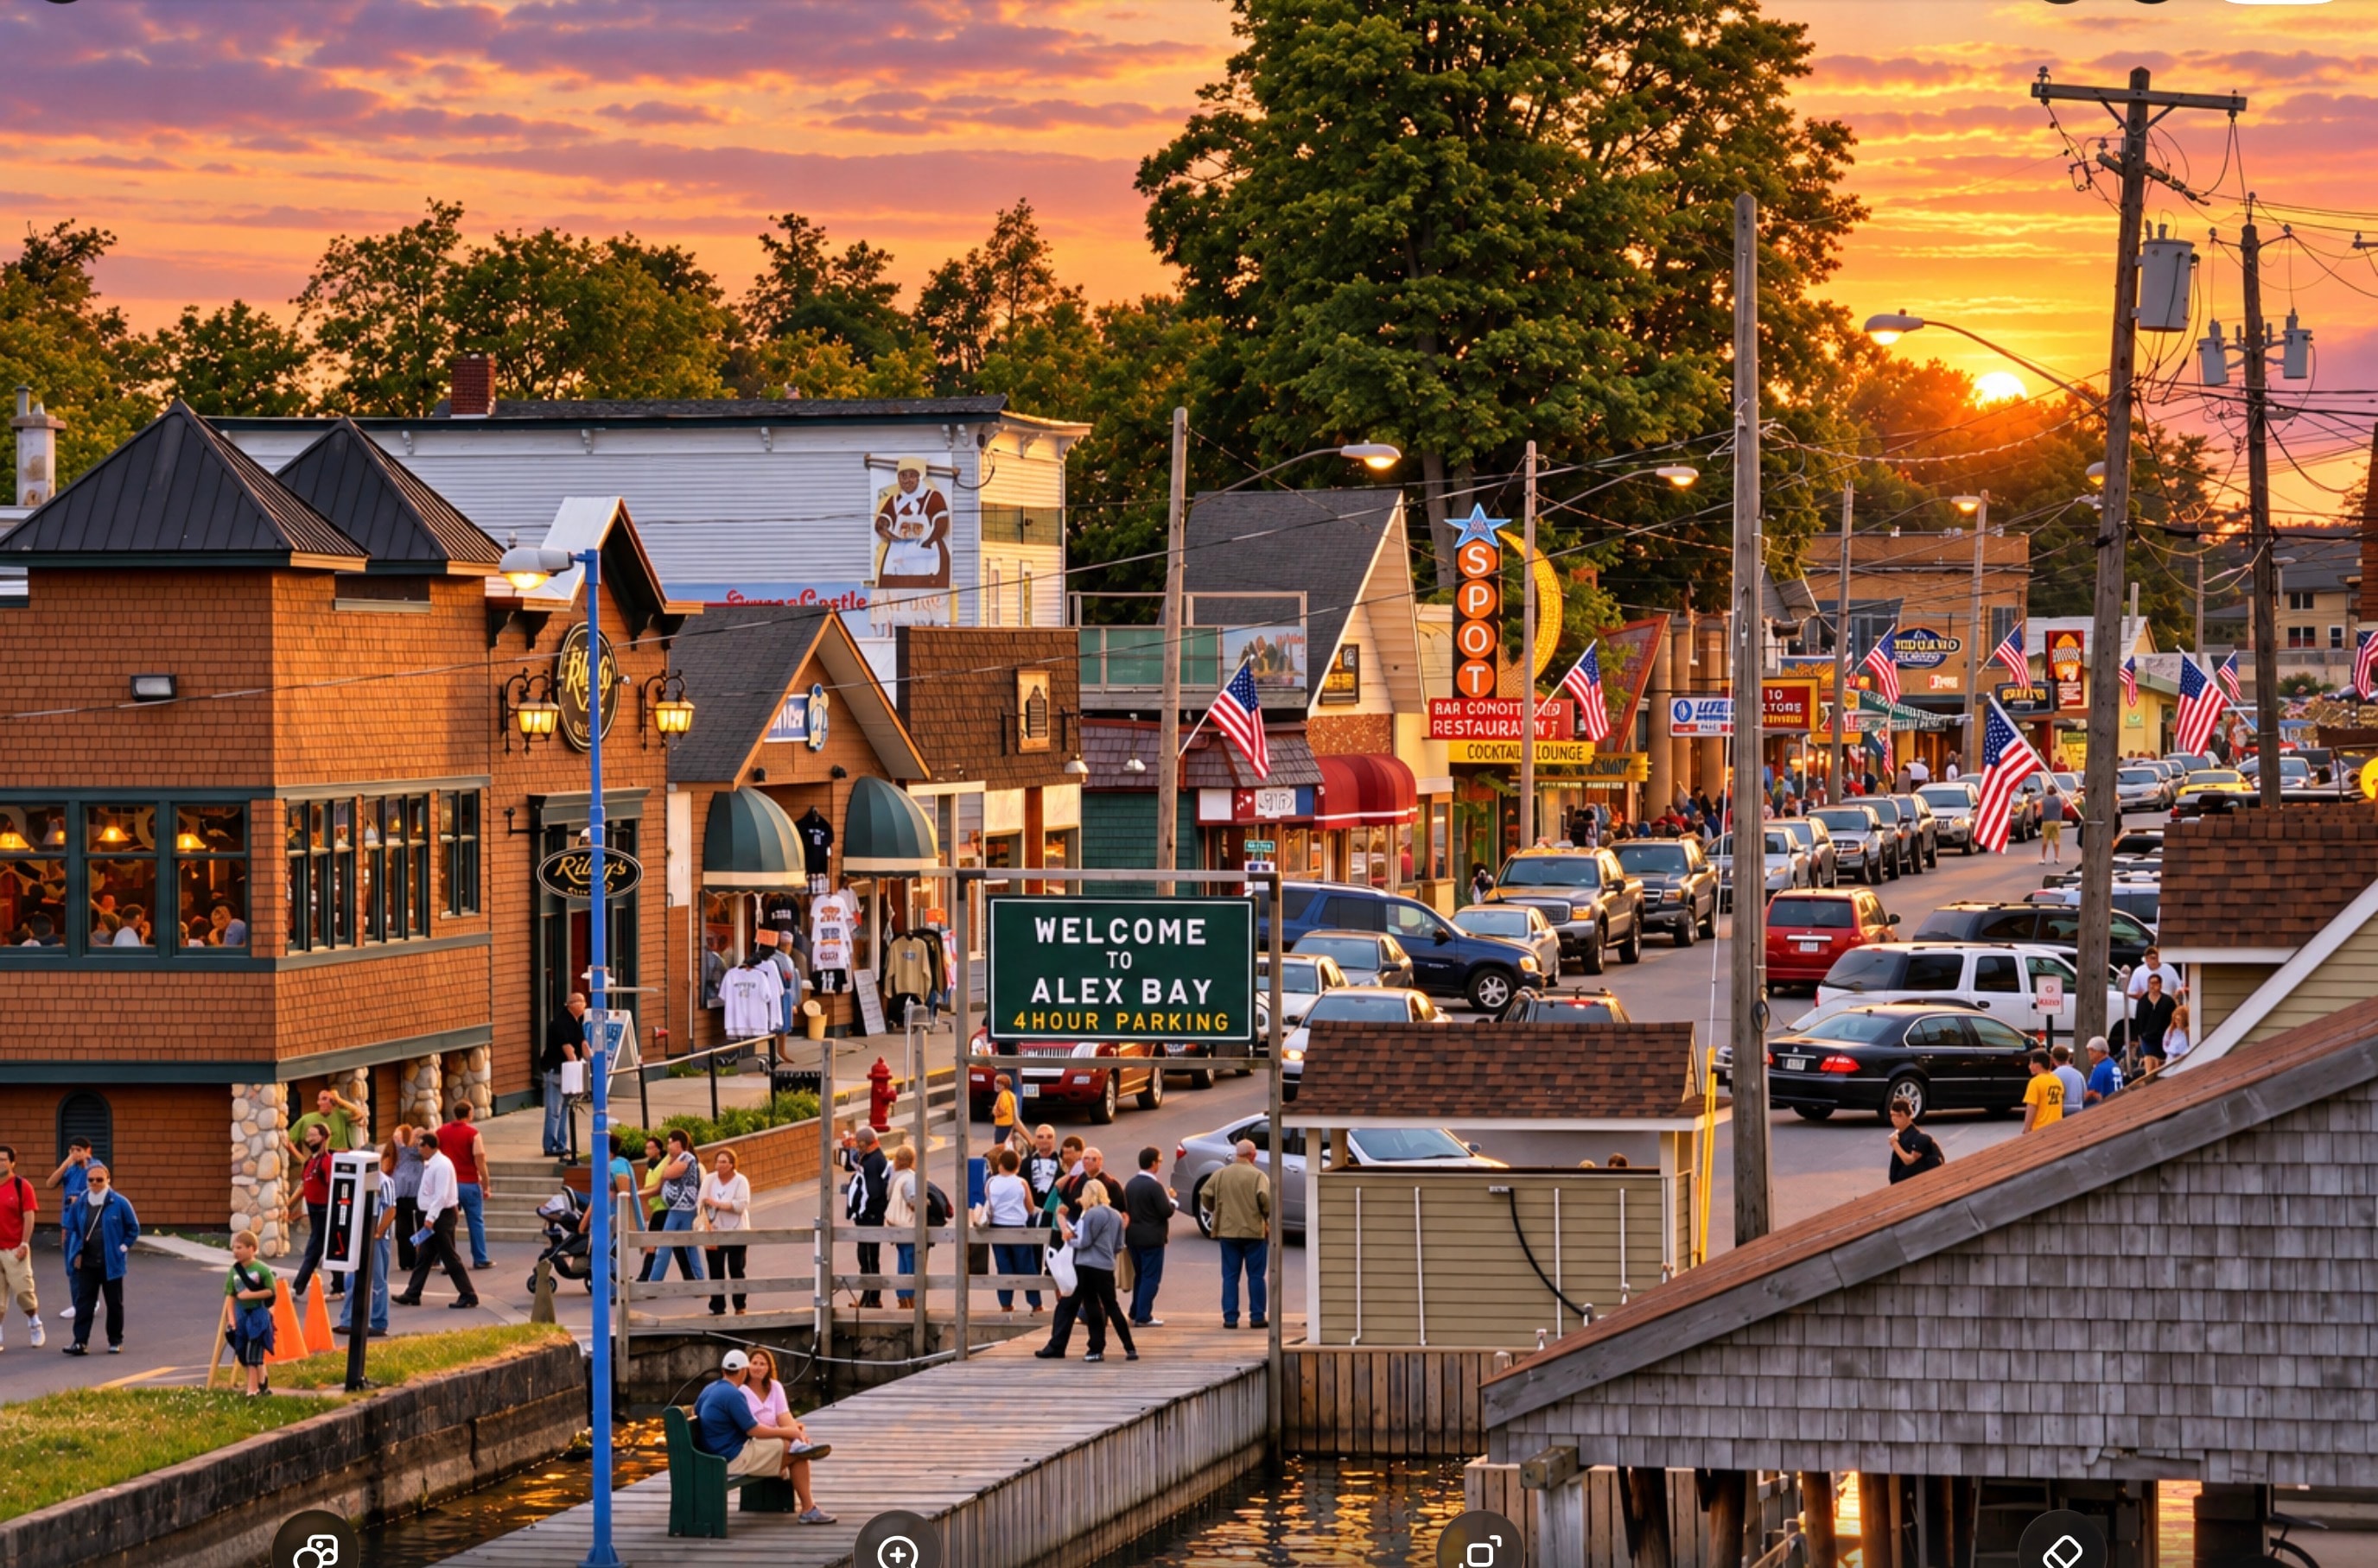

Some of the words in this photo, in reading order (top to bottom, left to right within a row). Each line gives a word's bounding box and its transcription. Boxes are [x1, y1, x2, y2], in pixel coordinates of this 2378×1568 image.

[1465, 545, 1489, 694] SPOT
[1467, 743, 1522, 760] COCKTAIL
[1536, 745, 1583, 761] LOUNGE
[1034, 917, 1207, 945] WELCOME
[1106, 951, 1133, 970] TO
[1030, 977, 1123, 1005] ALEX
[1141, 978, 1212, 1005] BAY
[1116, 1013, 1229, 1032] PARKING
